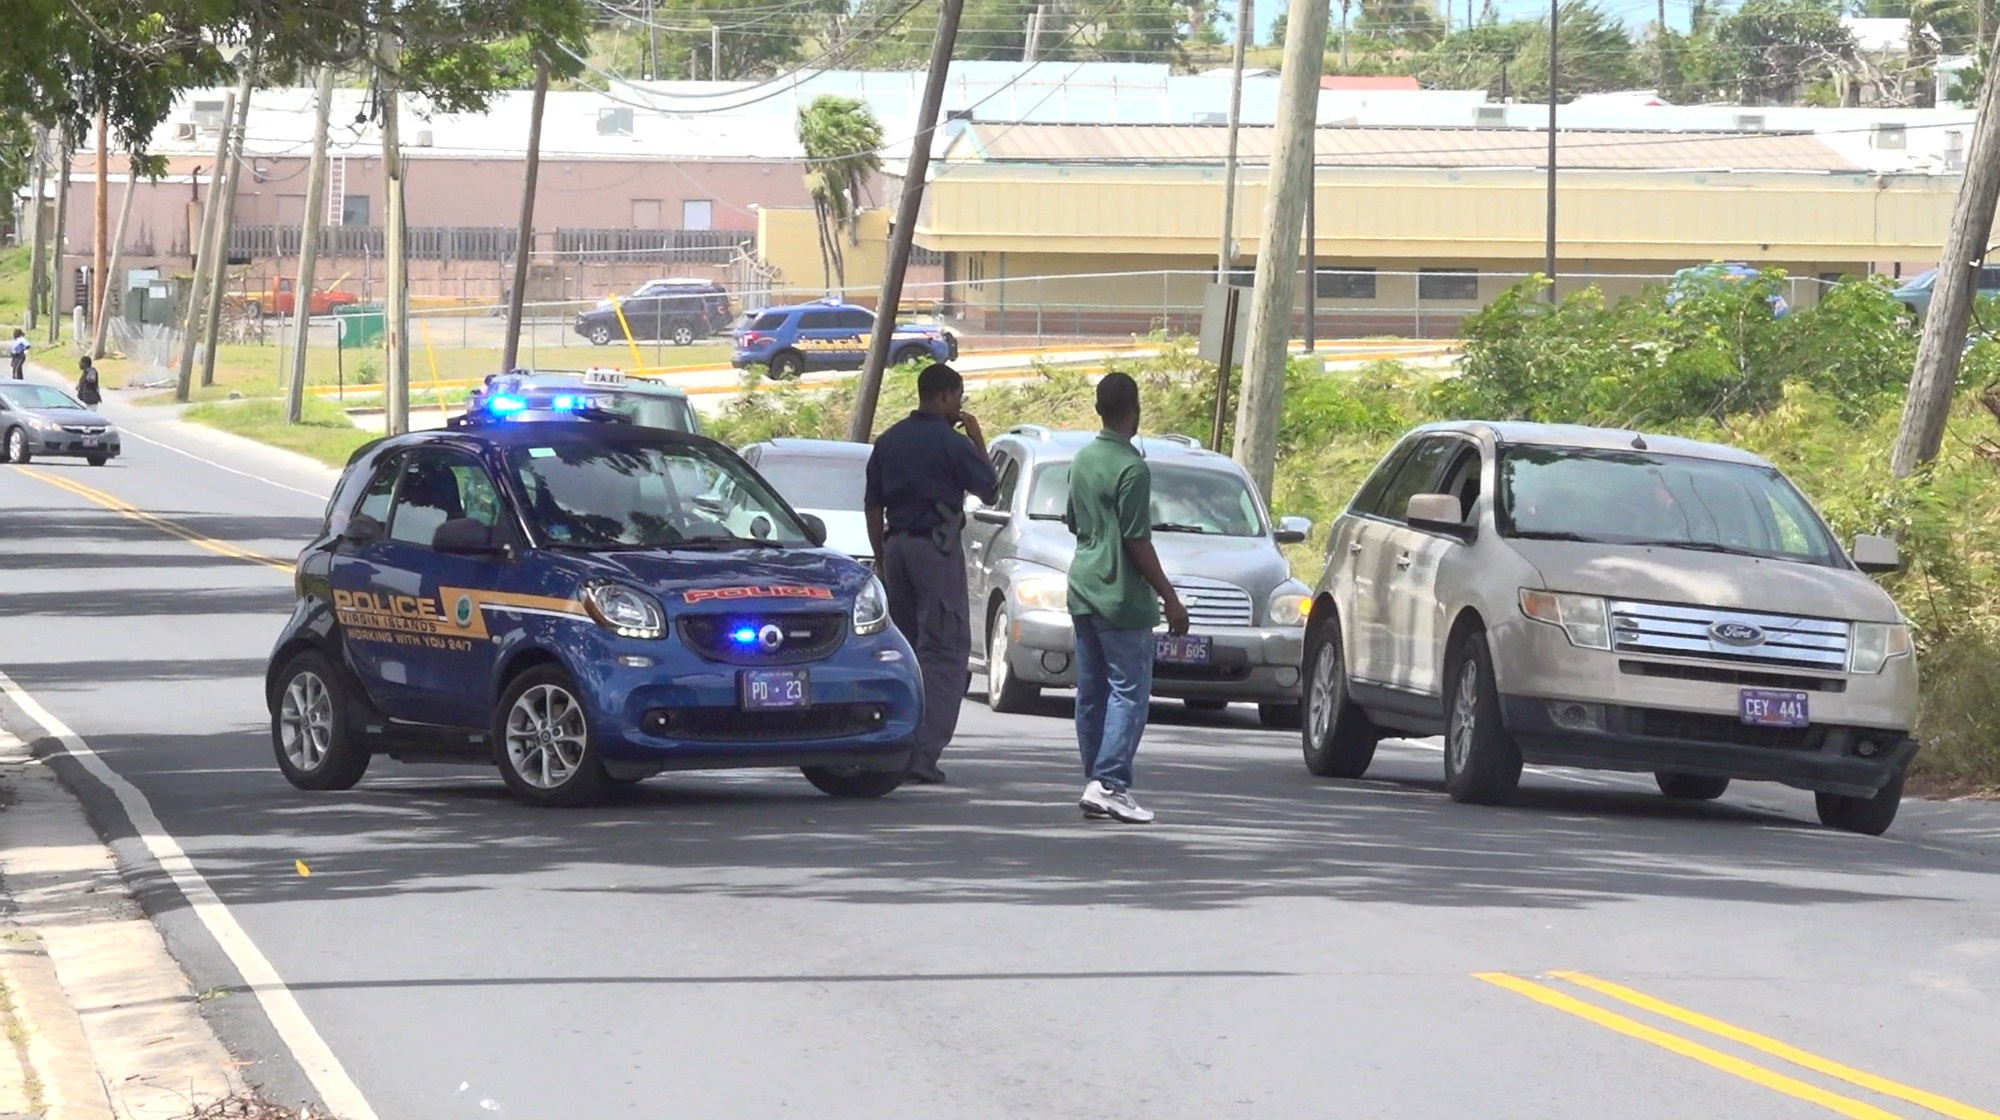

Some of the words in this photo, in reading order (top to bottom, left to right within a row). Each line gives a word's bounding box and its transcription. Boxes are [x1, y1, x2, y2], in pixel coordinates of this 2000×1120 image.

[594, 372, 620, 383] TAXI
[333, 589, 438, 620] POLICE
[683, 586, 834, 604] POLICE
[340, 613, 379, 626] VIRGIN
[384, 616, 437, 632] ISLANDS
[1724, 625, 1752, 638] Ford
[347, 628, 393, 643] WORKING
[395, 633, 421, 646] WITH
[422, 636, 446, 649] YOU
[447, 638, 472, 651] 24/7
[1156, 641, 1178, 657] CFW
[1186, 643, 1206, 658] 605
[752, 681, 768, 700] PD
[786, 680, 802, 699] 23
[1745, 698, 1769, 716] CEY
[1779, 700, 1803, 719] 441
